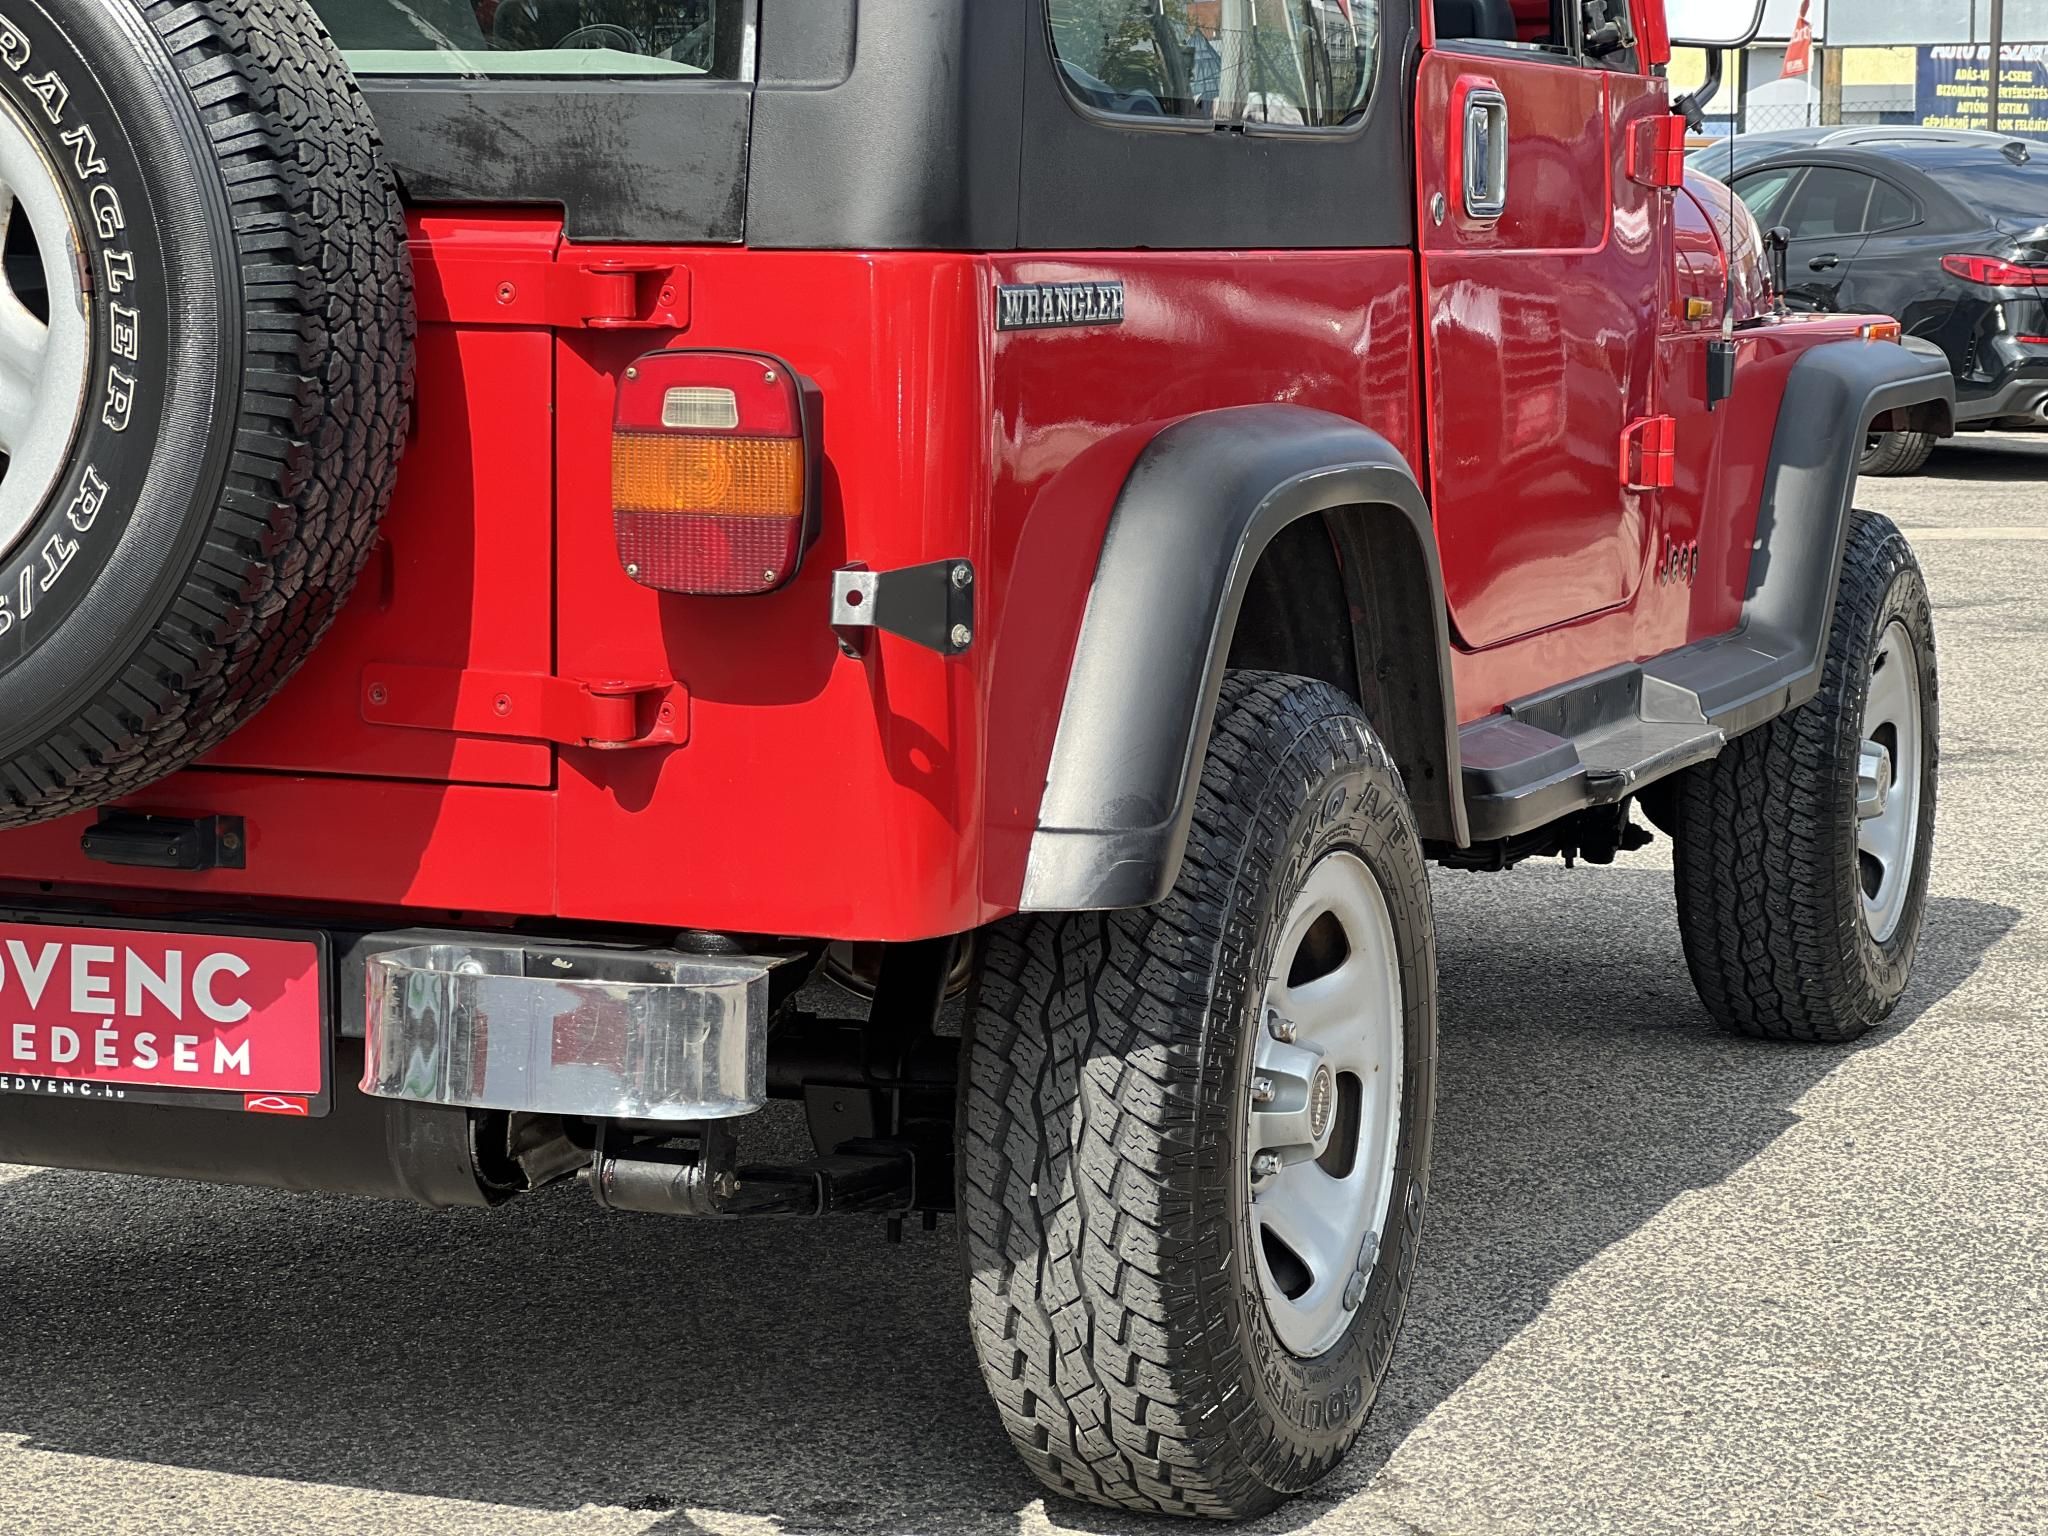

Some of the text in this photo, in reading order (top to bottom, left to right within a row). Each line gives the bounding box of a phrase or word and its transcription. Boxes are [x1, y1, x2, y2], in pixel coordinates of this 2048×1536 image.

[1936, 83, 1990, 98] BIZOMÁNYO
[1954, 67, 2033, 82] ADÁS-VL-CSERE
[1003, 285, 1124, 325] WRANGLER
[1659, 534, 1698, 588] Jeep
[0, 939, 252, 1023] VENC
[13, 1018, 251, 1076] EDÉSEM
